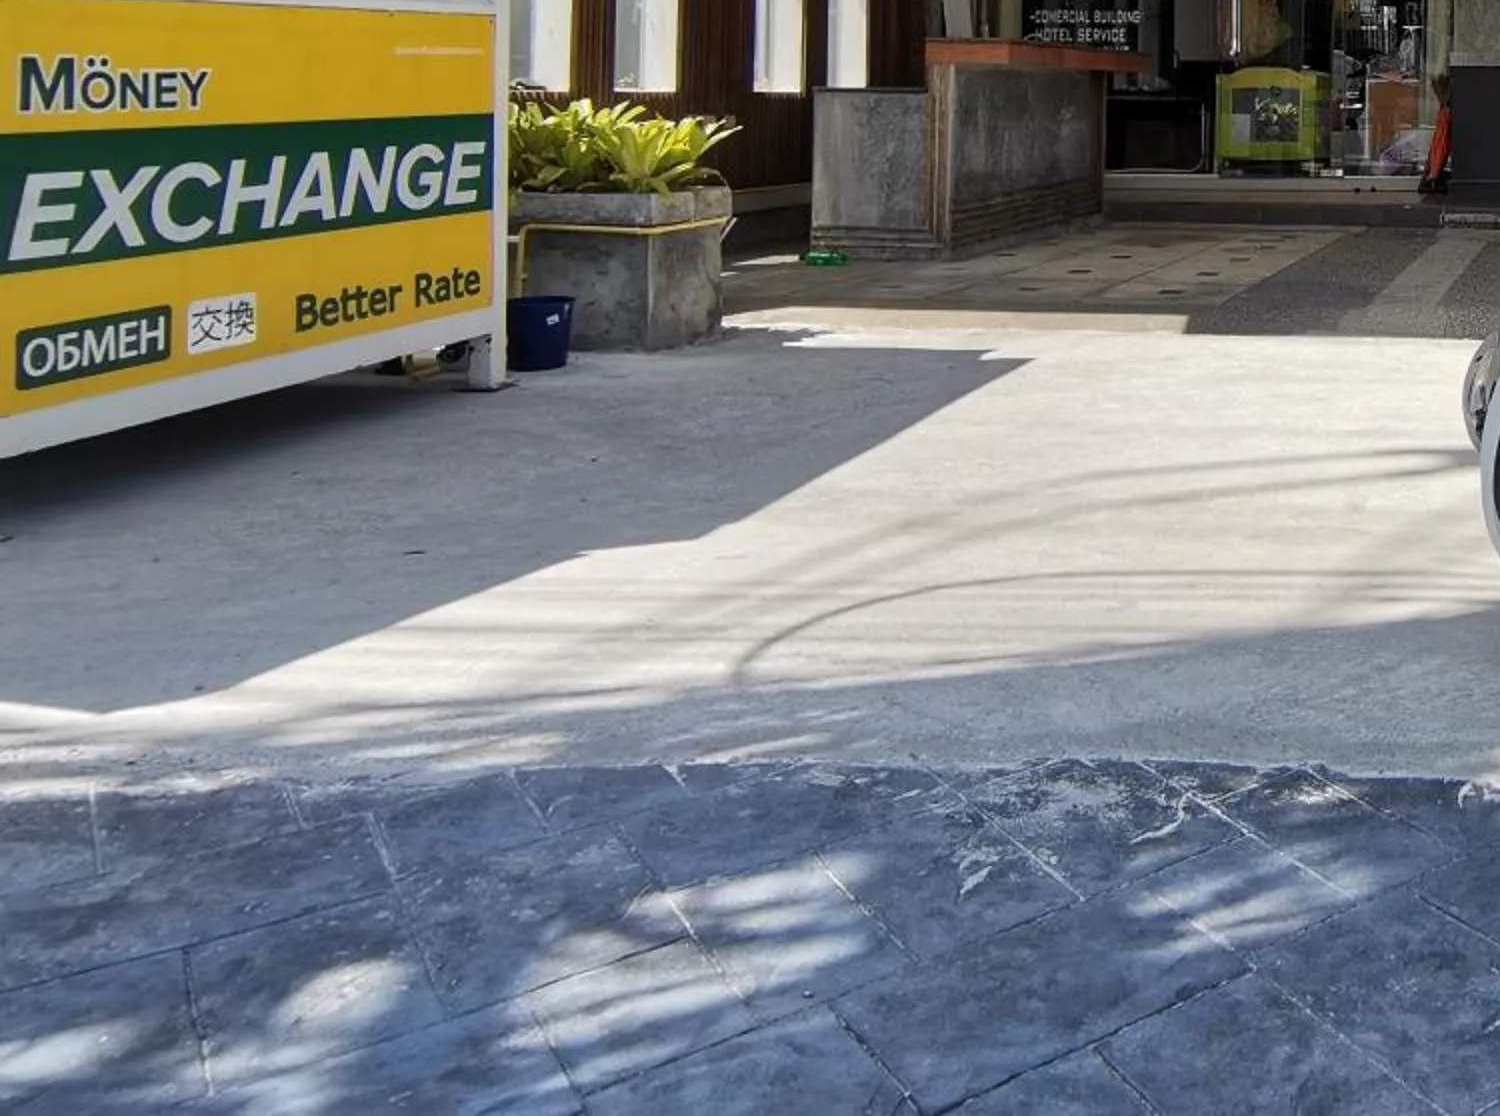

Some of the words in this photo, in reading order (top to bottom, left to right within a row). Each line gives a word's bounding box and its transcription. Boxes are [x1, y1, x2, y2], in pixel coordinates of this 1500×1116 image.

[8, 141, 487, 260] EXCHANGE
[190, 300, 256, 347] 交換
[296, 284, 402, 333] Better
[415, 268, 481, 308] Rate
[23, 316, 165, 378] ОБМЕН
